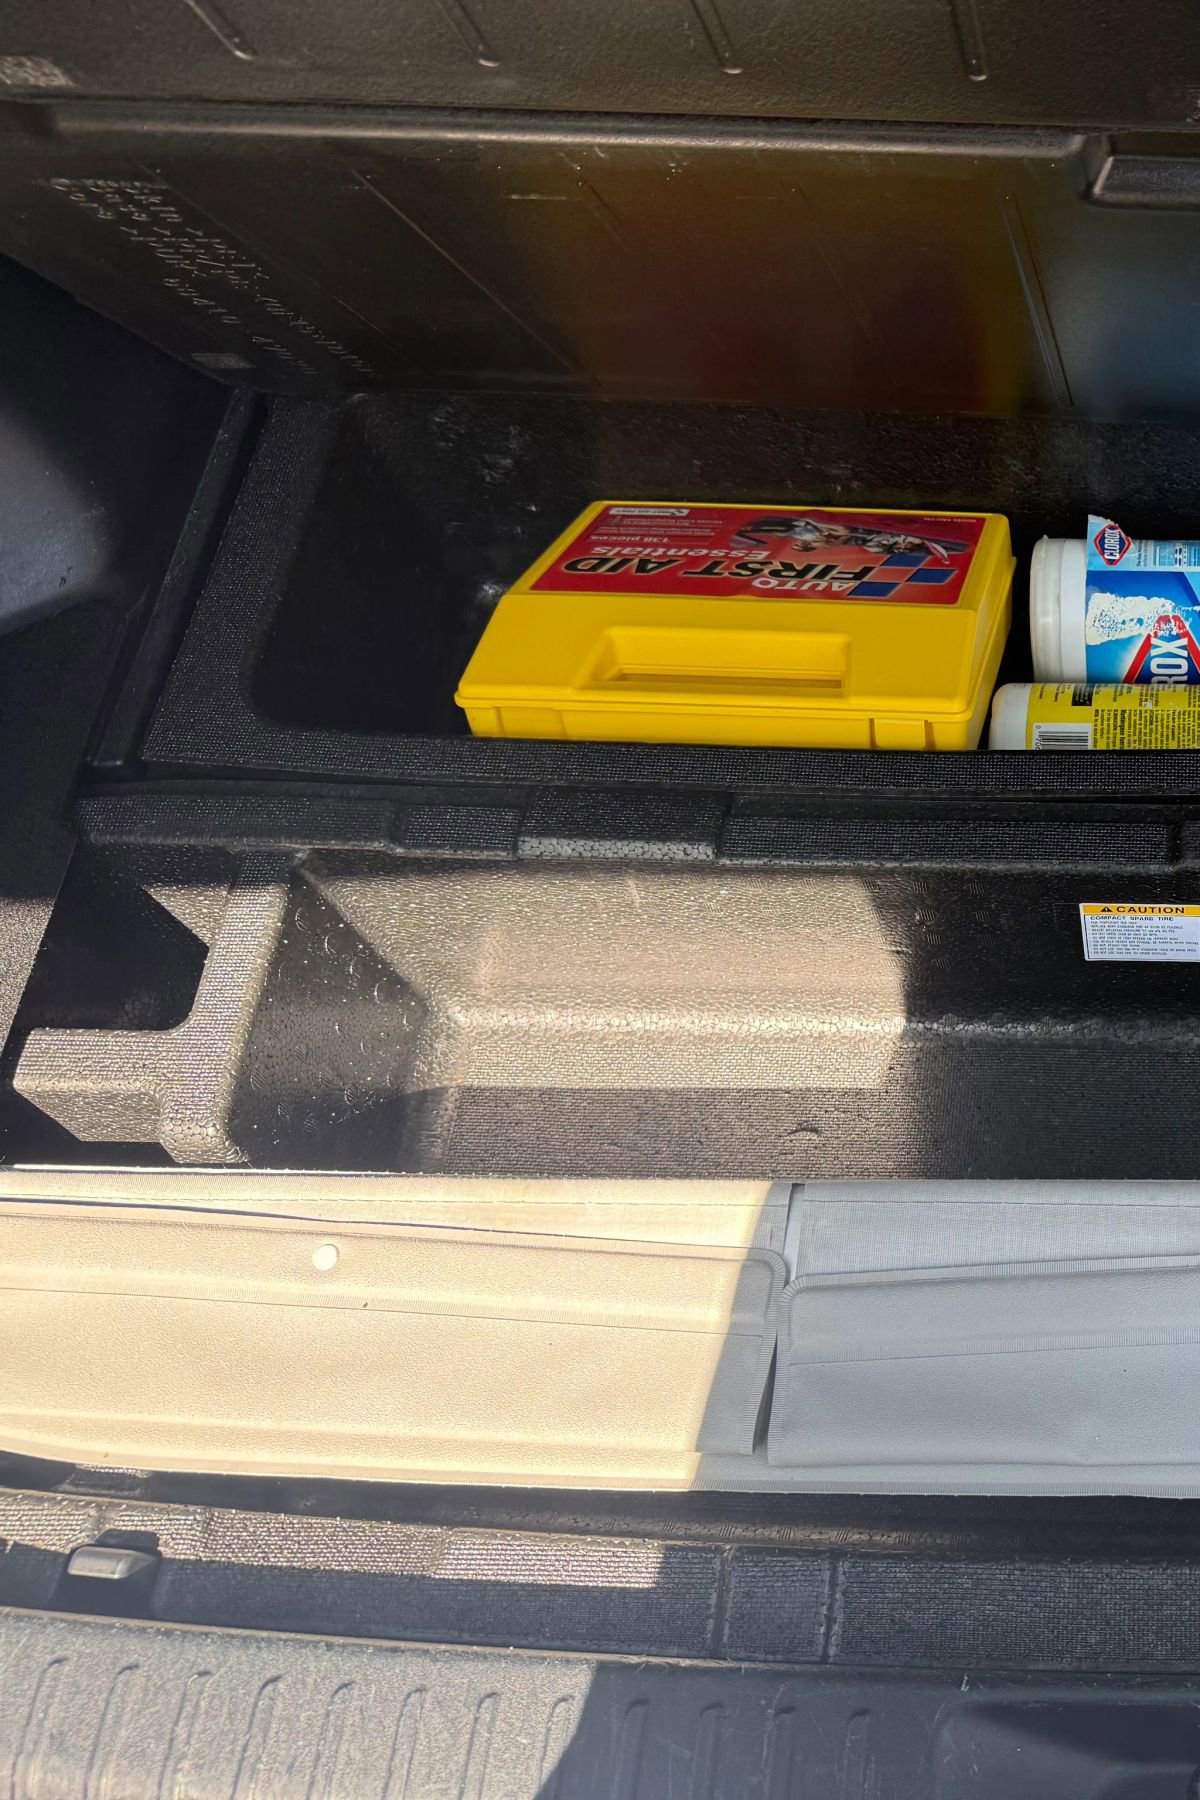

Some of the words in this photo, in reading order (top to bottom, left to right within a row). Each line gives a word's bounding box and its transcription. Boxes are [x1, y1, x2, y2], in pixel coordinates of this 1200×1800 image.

[1104, 528, 1120, 560] CLOROX
[591, 546, 770, 561] Essentials
[563, 557, 684, 574] AID
[680, 559, 880, 582] FIRST
[751, 577, 859, 592] AUTO
[1150, 637, 1188, 685] ROX
[1116, 906, 1185, 914] CAUTION
